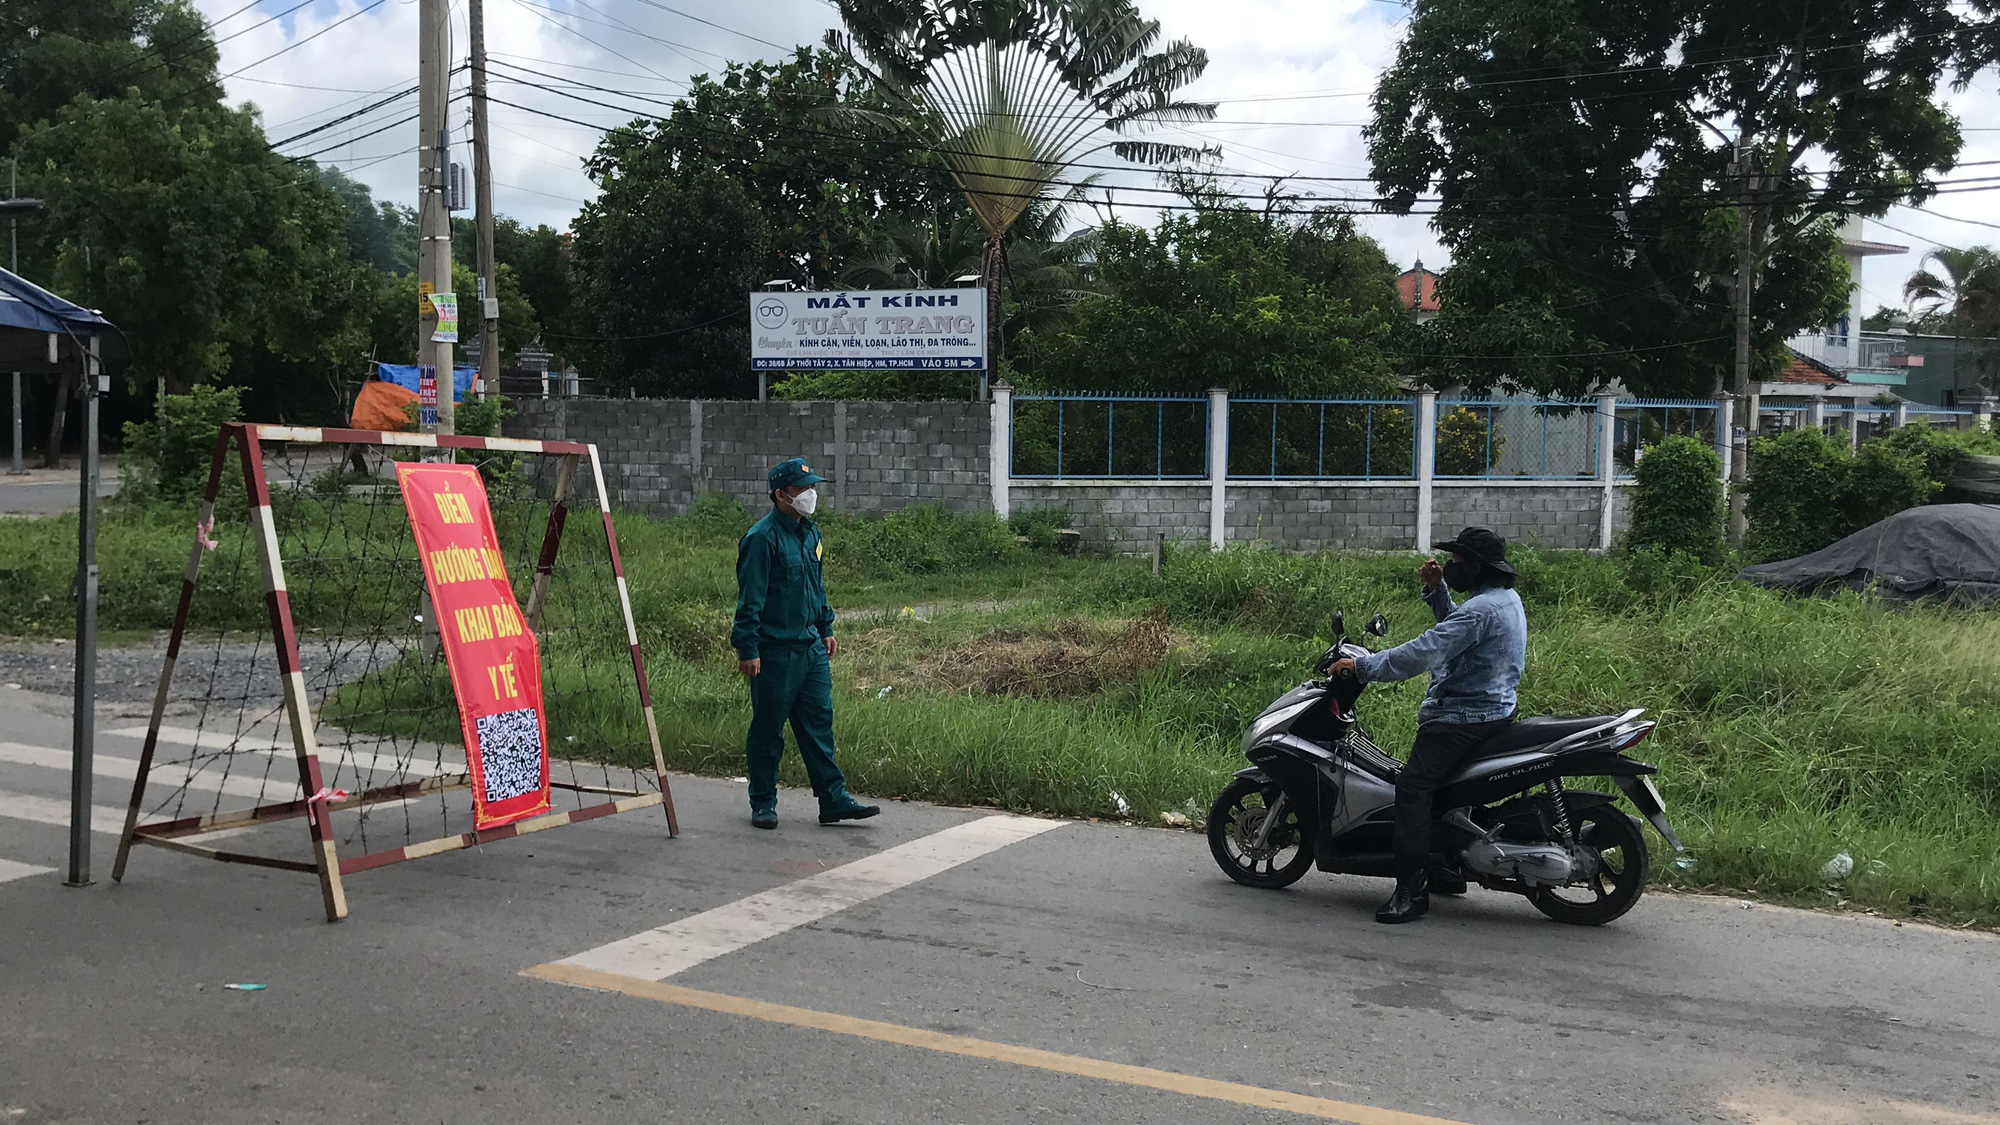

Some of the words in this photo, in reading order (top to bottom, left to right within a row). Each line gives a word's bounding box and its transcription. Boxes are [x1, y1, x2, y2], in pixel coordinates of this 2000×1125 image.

[807, 293, 871, 309] MẮT
[882, 293, 958, 308] KÍNH
[791, 309, 867, 335] TUẤN
[875, 315, 975, 335] TRANG
[799, 337, 819, 347] KÍNH
[820, 337, 840, 349] CẬN,
[842, 336, 864, 348] VIỄN,
[865, 339, 889, 349] LOẠN,
[891, 337, 907, 347] LÃO
[909, 338, 926, 349] THỊ,
[927, 338, 938, 347] ĐA
[813, 359, 825, 367] TÂY
[842, 359, 856, 367] TÂN
[875, 360, 888, 368] HM,
[889, 359, 914, 367] TP.HCM
[921, 358, 942, 367] VÀO
[433, 480, 474, 524] ĐIỂM
[429, 541, 485, 585] HƯỚNG
[454, 605, 494, 643] KHAI
[491, 596, 523, 638] BÁO
[487, 666, 500, 700] Y
[499, 652, 518, 699] TẾ
[1488, 772, 1510, 782] AIR
[1512, 760, 1555, 775] BLADE
